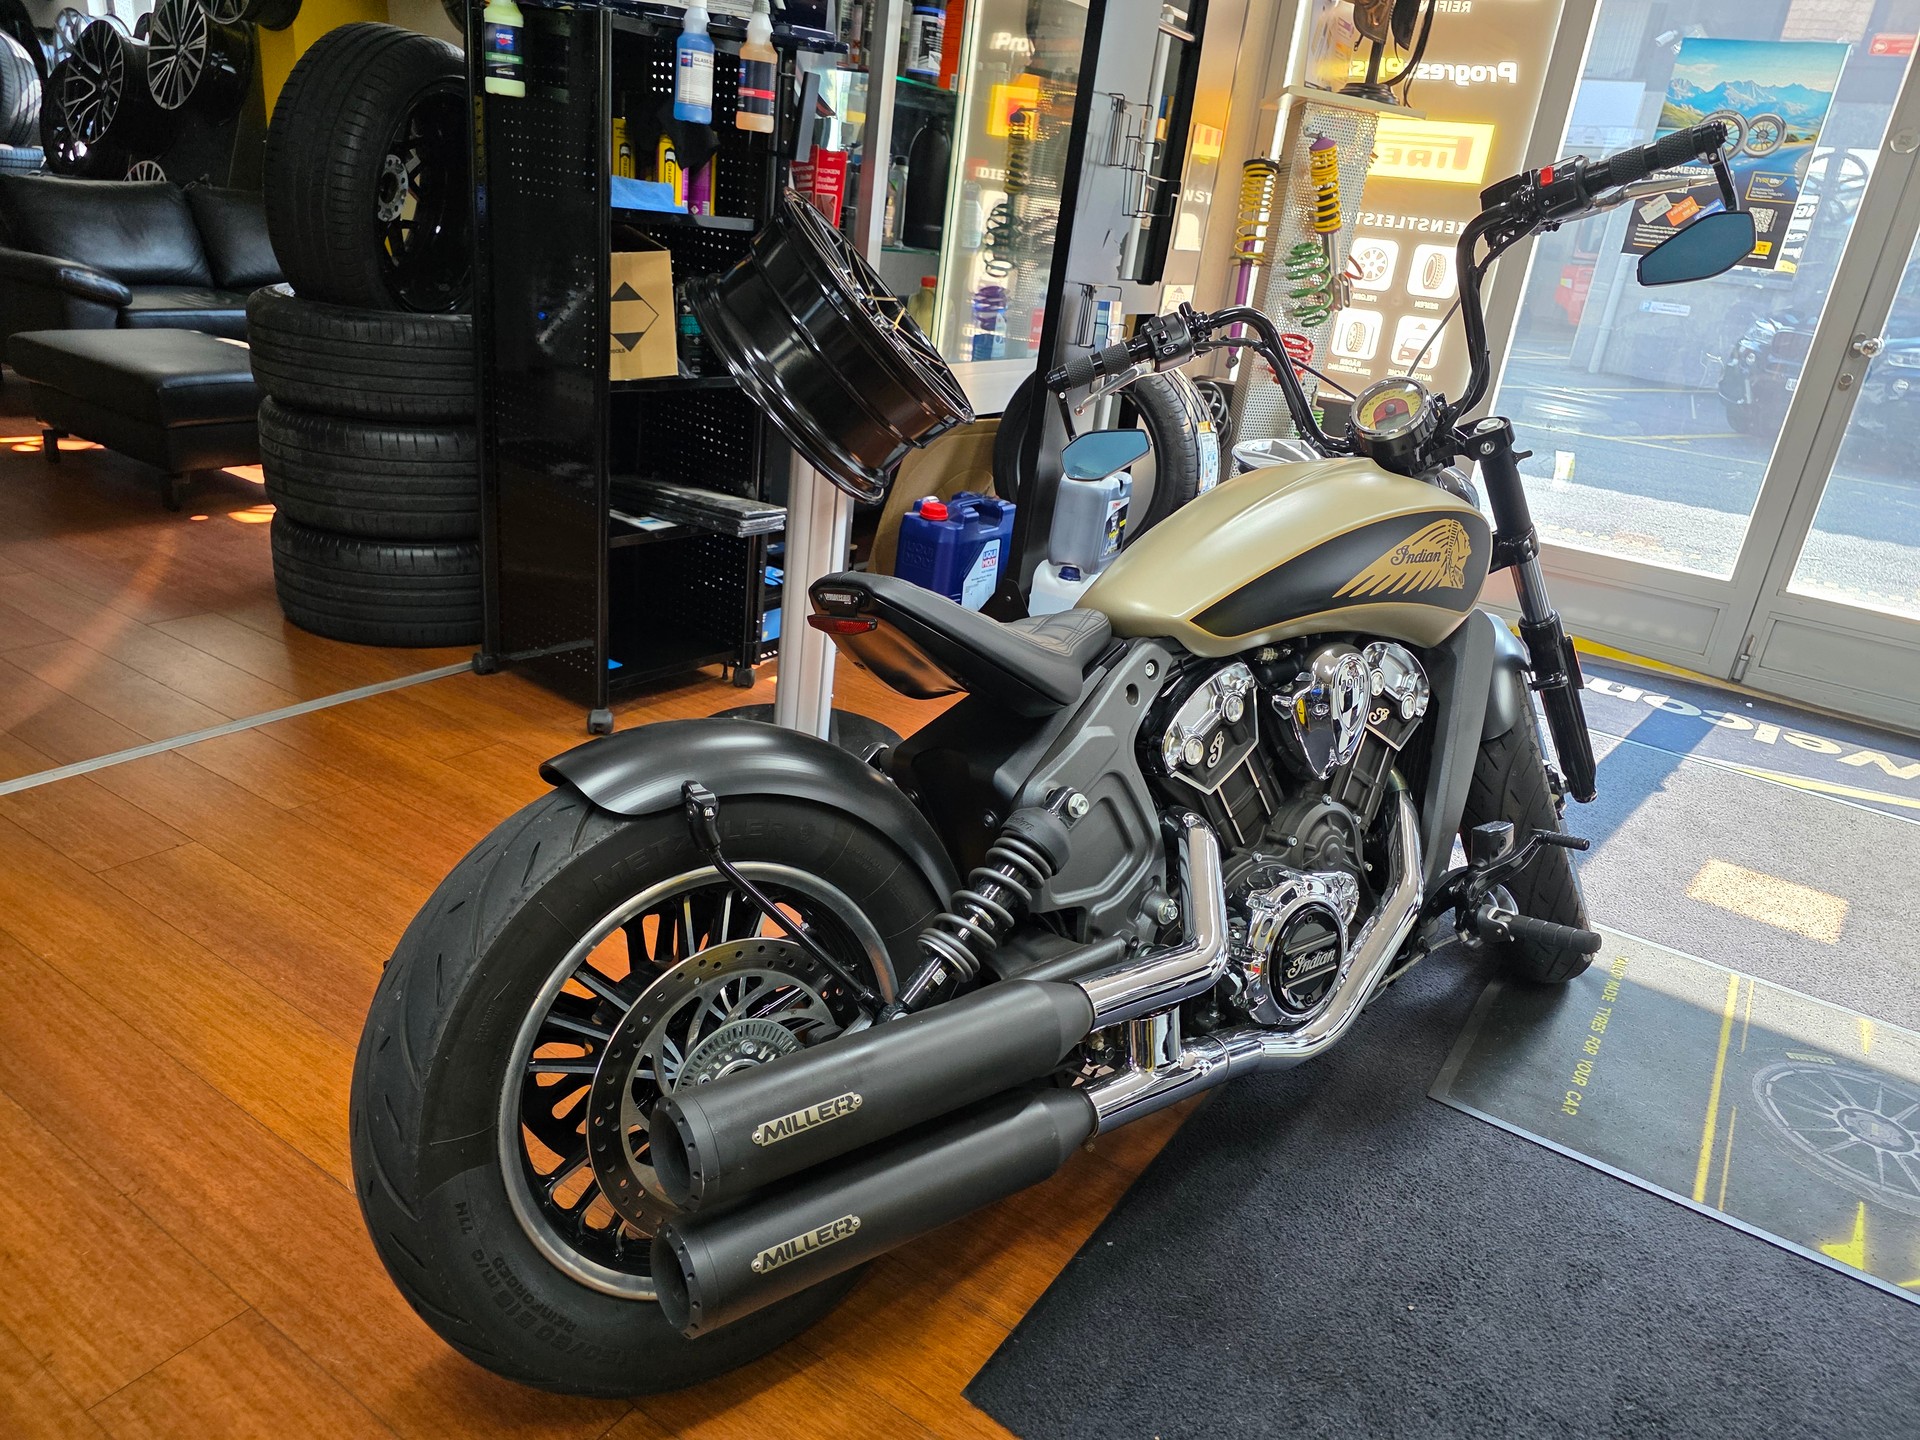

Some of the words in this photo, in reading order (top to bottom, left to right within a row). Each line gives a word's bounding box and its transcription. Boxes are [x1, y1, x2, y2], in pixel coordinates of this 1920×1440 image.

[1390, 544, 1441, 566] Indian
[1584, 677, 1920, 780] Welcom
[1287, 949, 1336, 979] Indian
[1601, 979, 1621, 1003] MADE
[1590, 1006, 1612, 1034] TYRES
[1582, 1034, 1602, 1056] FOR
[1571, 1058, 1594, 1087] YOUR
[1561, 1090, 1582, 1116] CAR
[763, 1095, 855, 1143] MILLER
[762, 1218, 853, 1270] MILLER
